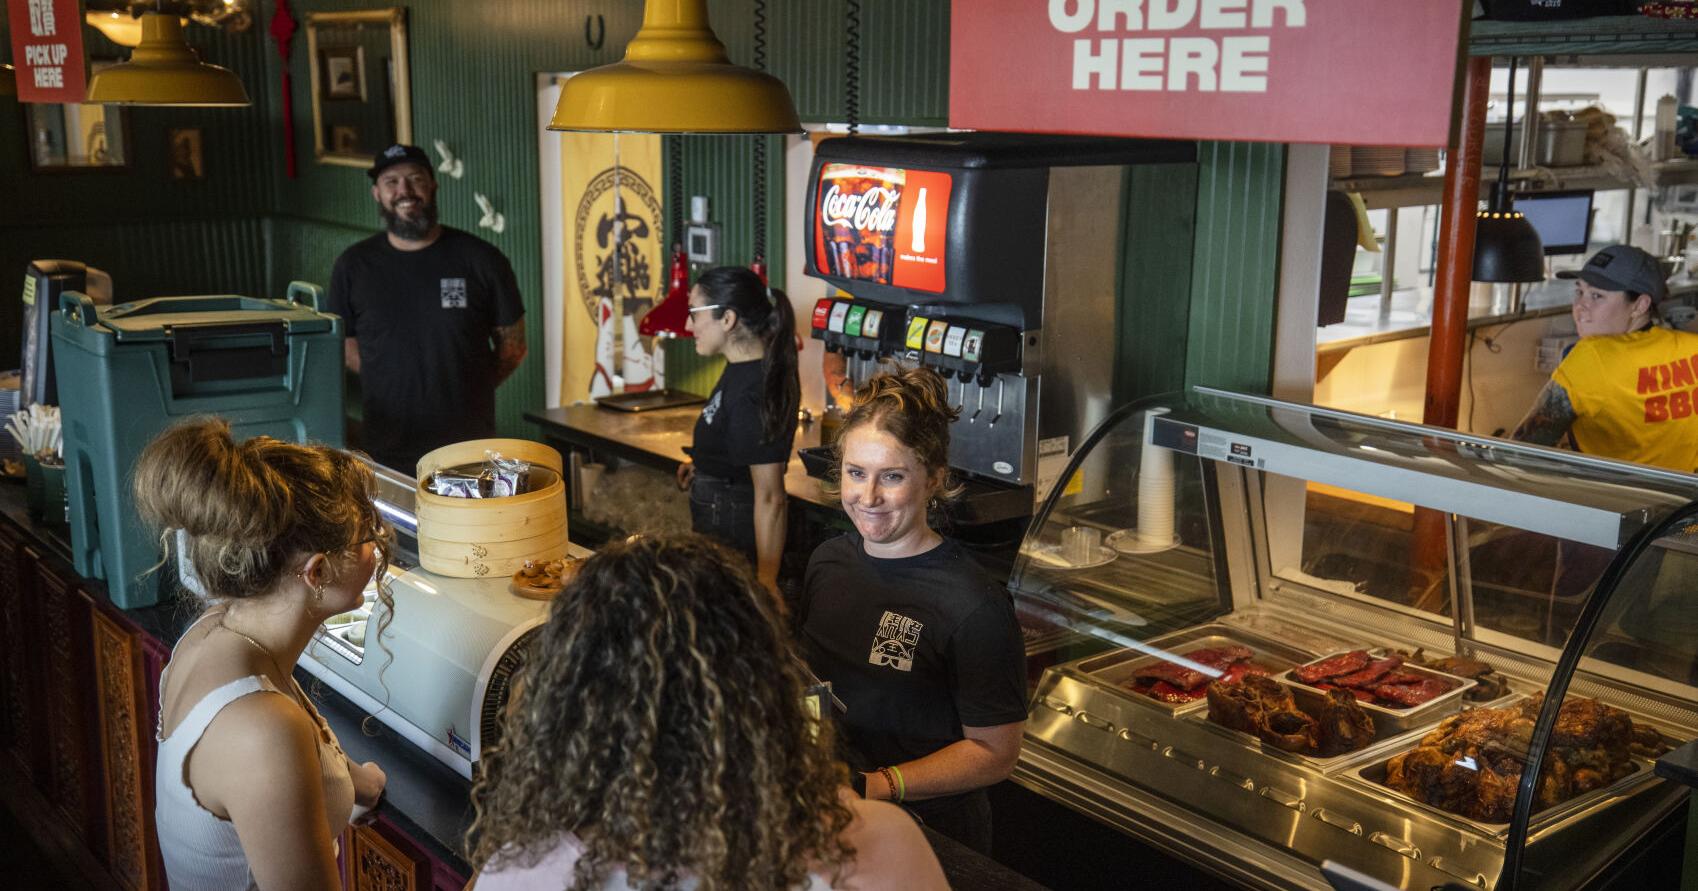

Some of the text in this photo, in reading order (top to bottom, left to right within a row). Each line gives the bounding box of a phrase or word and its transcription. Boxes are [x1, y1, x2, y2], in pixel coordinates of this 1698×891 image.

[25, 44, 67, 66] PICK UP
[1072, 36, 1270, 91] HERE
[34, 67, 64, 88] HERE
[823, 185, 900, 231] Coca-Cola
[1637, 353, 1698, 395] KIN
[1645, 388, 1698, 423] BB
